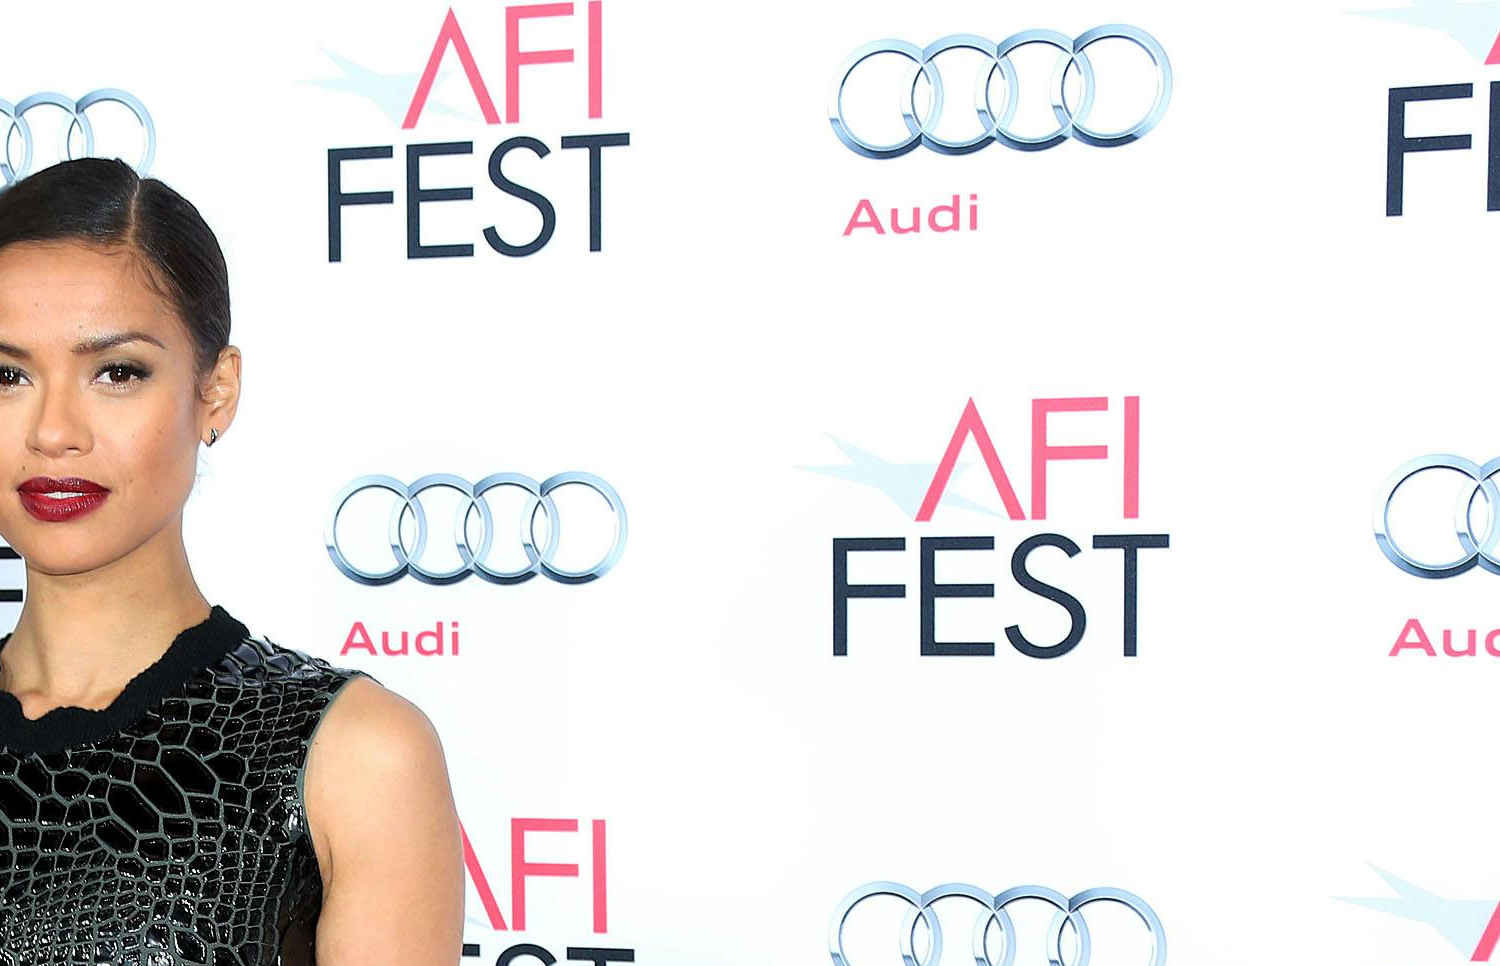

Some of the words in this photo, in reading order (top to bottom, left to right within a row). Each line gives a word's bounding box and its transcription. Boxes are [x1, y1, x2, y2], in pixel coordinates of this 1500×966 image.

[402, 0, 602, 129] AFI
[328, 133, 630, 262] FEST
[843, 194, 978, 236] Audi
[915, 395, 1141, 522] AFI
[339, 620, 460, 657] Audi
[832, 533, 1170, 659] FEST
[1388, 618, 1500, 658] Au
